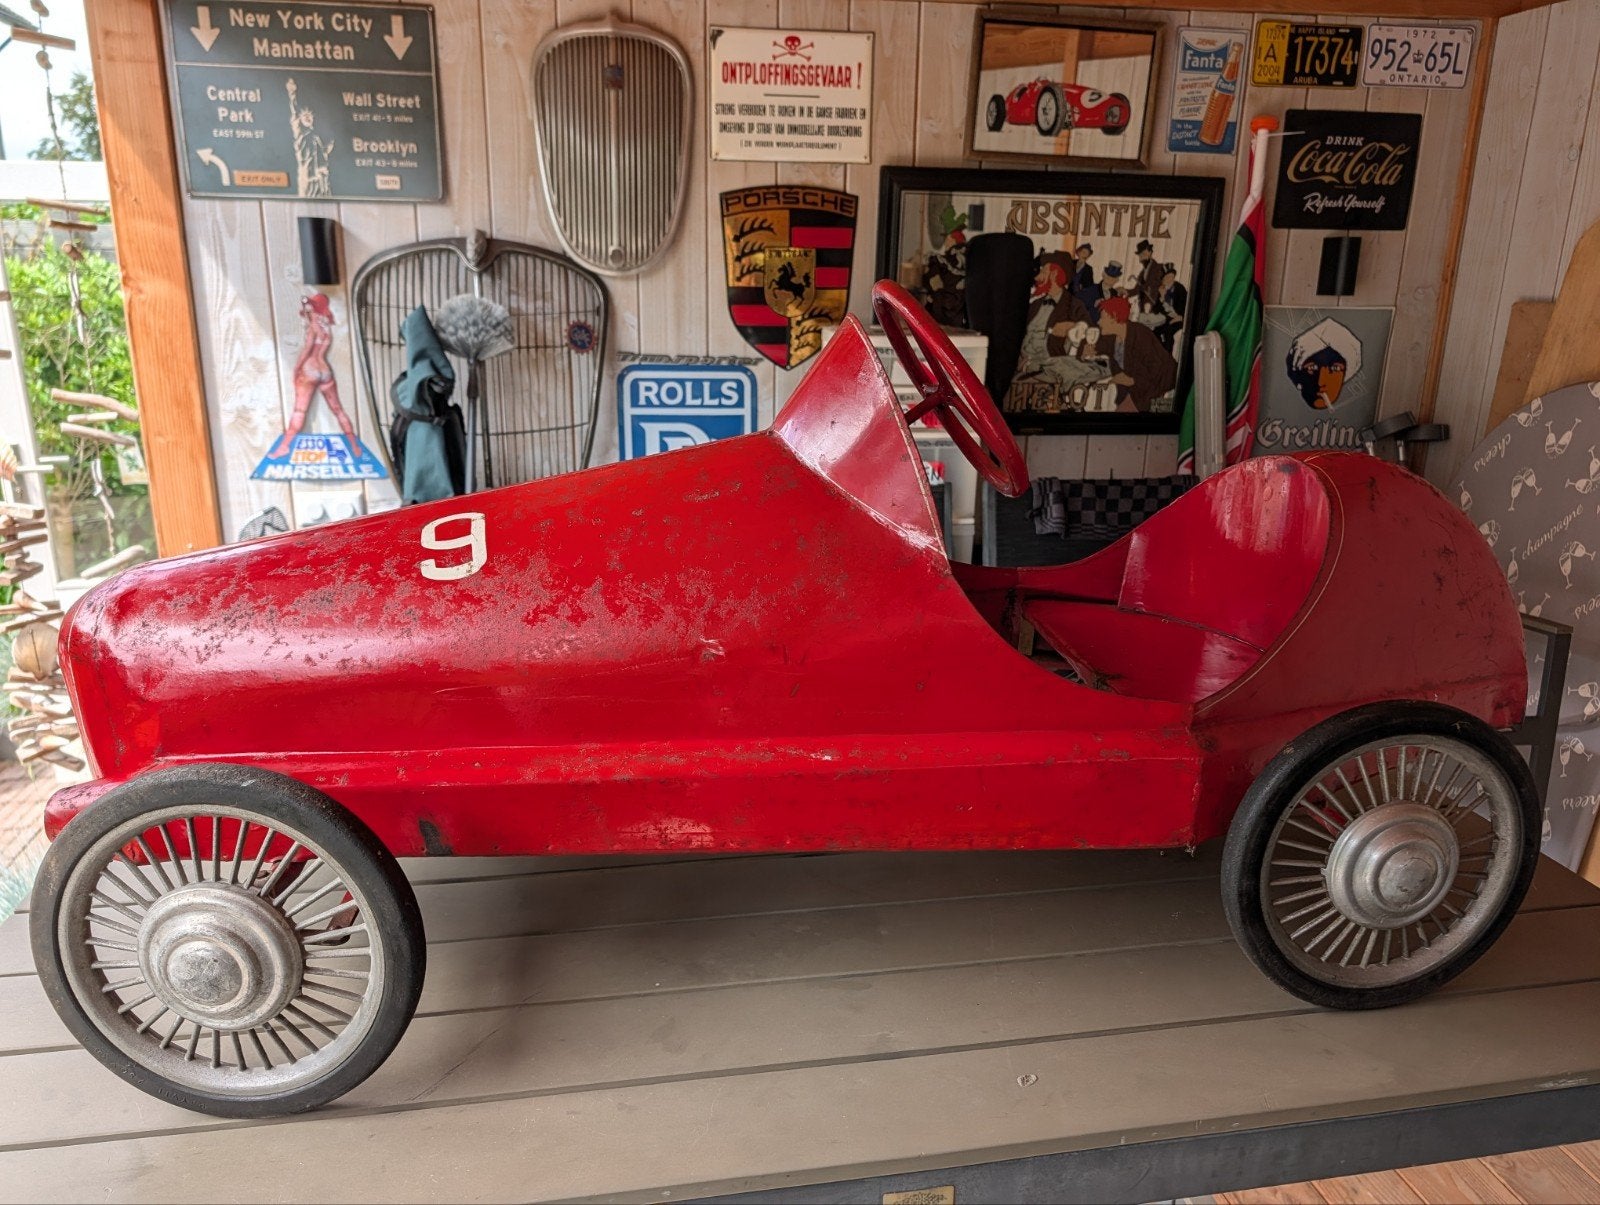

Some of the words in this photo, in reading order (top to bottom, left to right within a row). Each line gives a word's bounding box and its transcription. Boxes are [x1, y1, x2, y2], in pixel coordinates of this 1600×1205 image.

[229, 8, 270, 28] New
[276, 10, 324, 31] York
[331, 13, 373, 38] City
[1406, 29, 1437, 39] 1972
[253, 38, 355, 61] Manhattan
[1184, 50, 1223, 69] Fanta
[1293, 36, 1354, 75] 17374
[1369, 38, 1411, 72] 952
[1424, 42, 1464, 75] 65L
[721, 61, 852, 88] ONTPLOFFINGSGEVAAR
[1257, 64, 1280, 77] 2004
[1389, 74, 1441, 84] ONTARIO
[206, 85, 261, 103] Central
[342, 91, 372, 107] Wall
[375, 93, 421, 109] Street
[217, 107, 254, 123] Park
[352, 112, 371, 122] EXIT
[352, 136, 418, 157] Brooklyn
[1325, 135, 1364, 146] DRINK
[1286, 139, 1411, 186] Coca-Cola
[725, 190, 854, 216] PORSCHE
[1303, 192, 1347, 214] Refresh
[1344, 194, 1386, 214] Yourself
[1005, 200, 1176, 239] ABSINTHE
[638, 381, 739, 406] ROLLS
[262, 464, 380, 479] MARSEILLE
[1521, 503, 1584, 561] champagne
[419, 511, 488, 581] 9
[1562, 794, 1600, 816] heers
